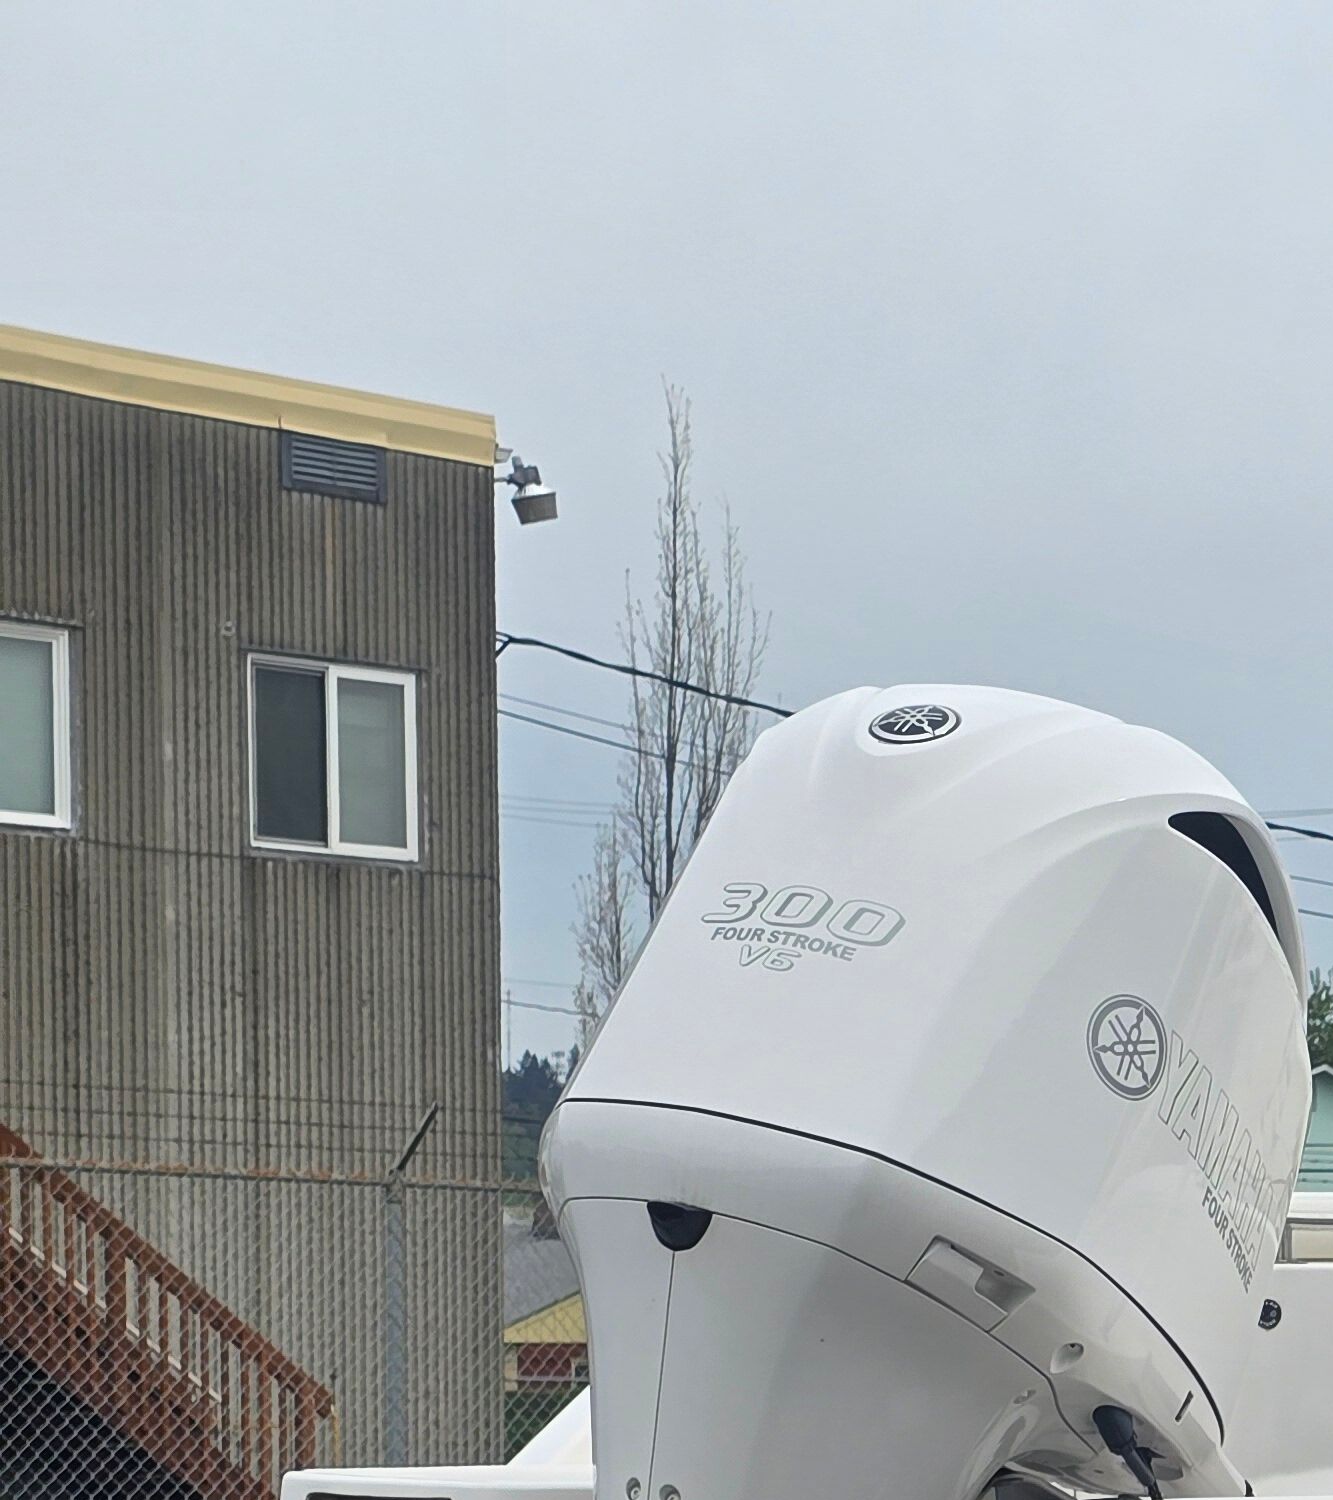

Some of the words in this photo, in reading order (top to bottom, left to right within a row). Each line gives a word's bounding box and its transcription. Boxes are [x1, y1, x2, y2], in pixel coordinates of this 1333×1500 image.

[701, 882, 906, 946] 300
[710, 926, 766, 941] FOUR
[767, 930, 857, 962] STROKE
[739, 943, 803, 972] V6
[1158, 1029, 1276, 1272] YAMAHA
[1202, 1186, 1229, 1241] FOUR
[1226, 1227, 1253, 1294] STROKE
